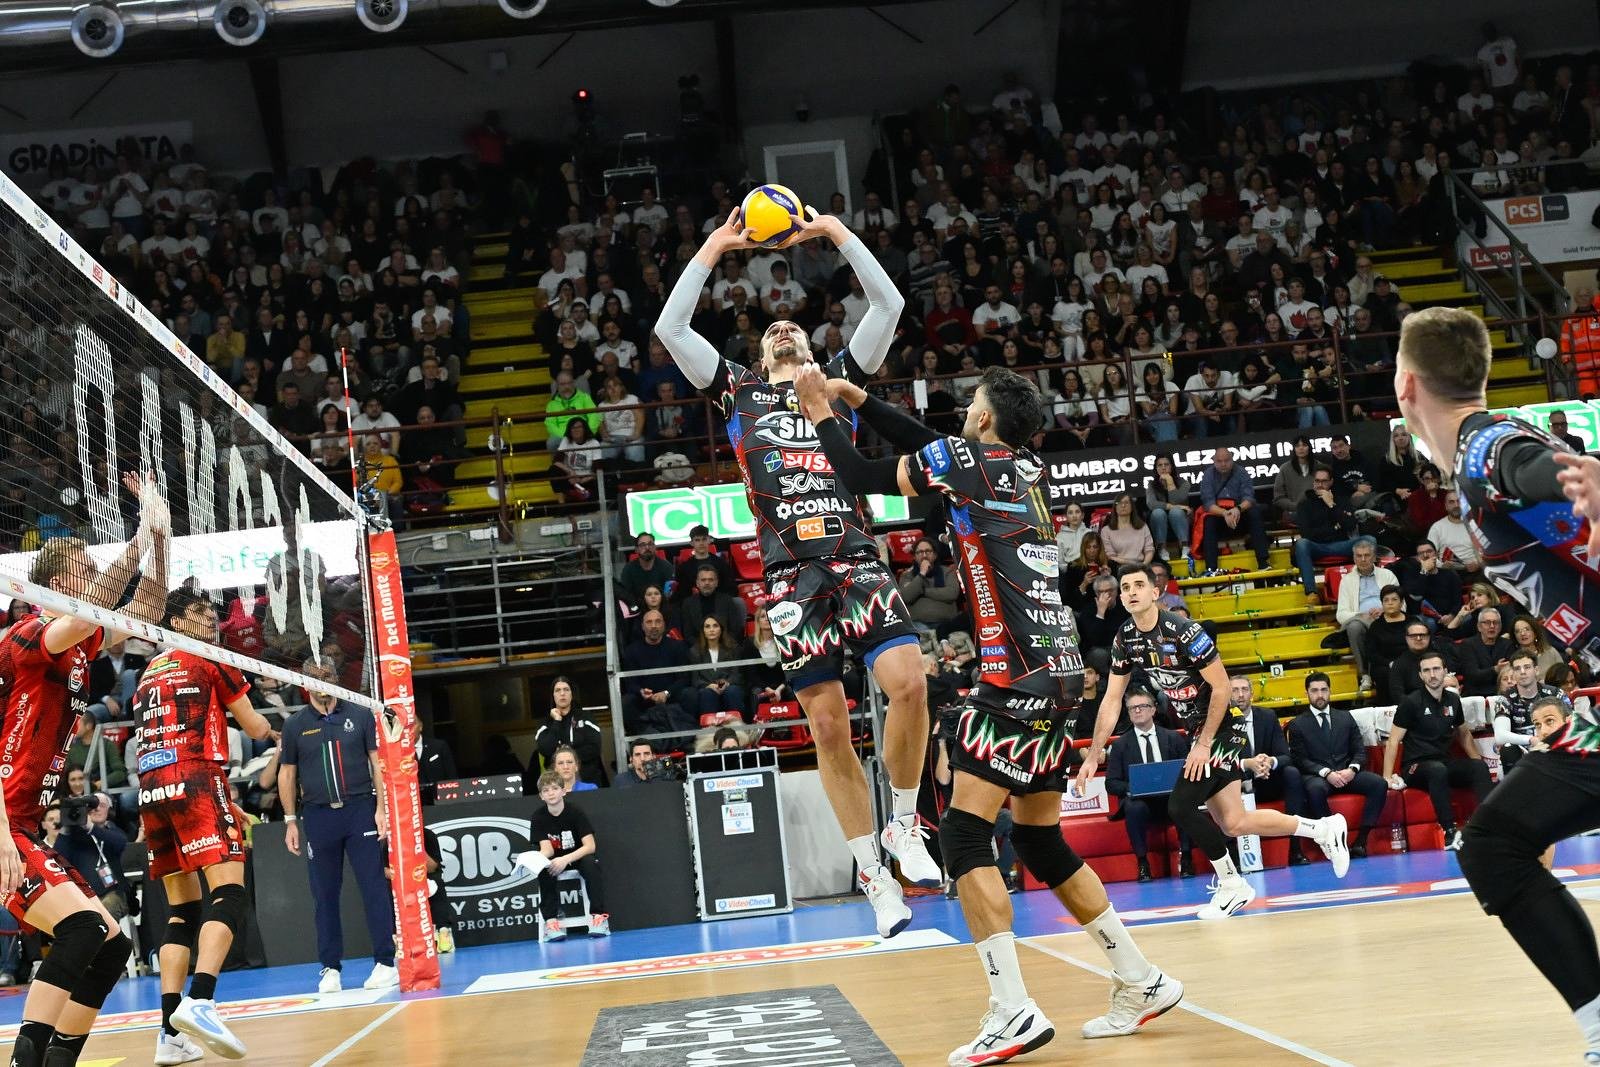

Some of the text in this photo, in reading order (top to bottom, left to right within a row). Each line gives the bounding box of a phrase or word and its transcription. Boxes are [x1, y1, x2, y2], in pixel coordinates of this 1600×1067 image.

[1508, 203, 1538, 219] PCS
[1052, 456, 1138, 479] UMBRO
[1028, 486, 1050, 523] 11
[799, 523, 822, 534] PCS
[969, 564, 988, 618] FRANCESCO
[976, 563, 997, 617] ALLEGRETTI
[376, 574, 400, 647] Del Monte
[1025, 609, 1057, 626] VUS
[981, 647, 1006, 656] FRIA
[982, 661, 1008, 672] OMO
[1273, 664, 1281, 676] D
[149, 686, 161, 708] 21
[769, 706, 789, 714] C34
[144, 723, 186, 739] Electrolux
[140, 749, 174, 770] CREO
[716, 777, 760, 788] VideoCheck
[409, 782, 423, 853] Del Monte
[182, 834, 221, 854] endotek
[478, 889, 579, 913] SYSTM
[728, 898, 772, 908] VideoCheck
[417, 889, 436, 959] Del Monte
